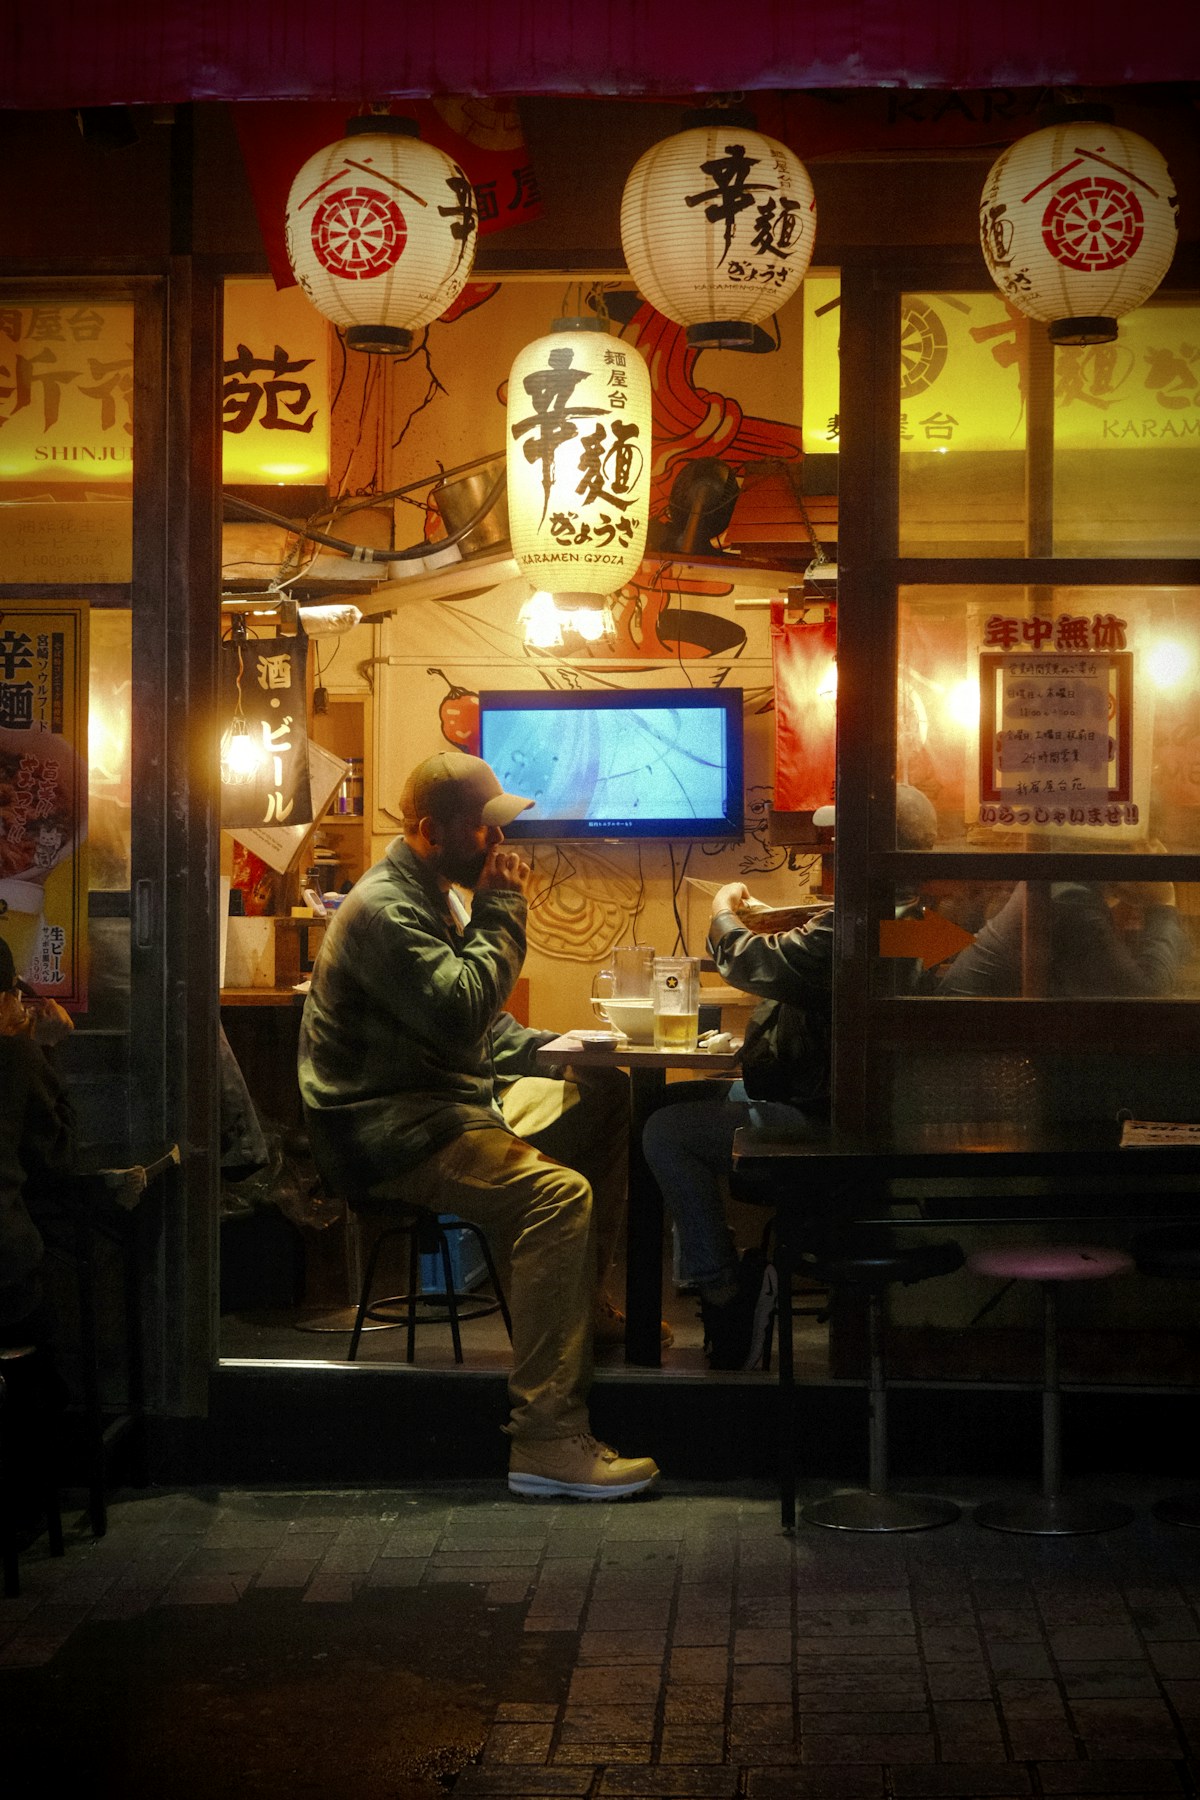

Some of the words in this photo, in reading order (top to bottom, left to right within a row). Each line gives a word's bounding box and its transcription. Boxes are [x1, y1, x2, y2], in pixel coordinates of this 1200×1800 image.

[727, 260, 794, 287] ぎょうざ
[603, 348, 629, 409] 麺屋台
[34, 446, 133, 461] SHINJU
[549, 511, 640, 548] ぎょうざ
[521, 552, 579, 565] KARAMEN
[584, 553, 624, 566] GYOZA
[985, 615, 1127, 650] 年中無休
[36, 633, 50, 733] 宮崎ソウルフード
[256, 653, 294, 823] 酒・ビール
[50, 926, 65, 982] 生ビール
